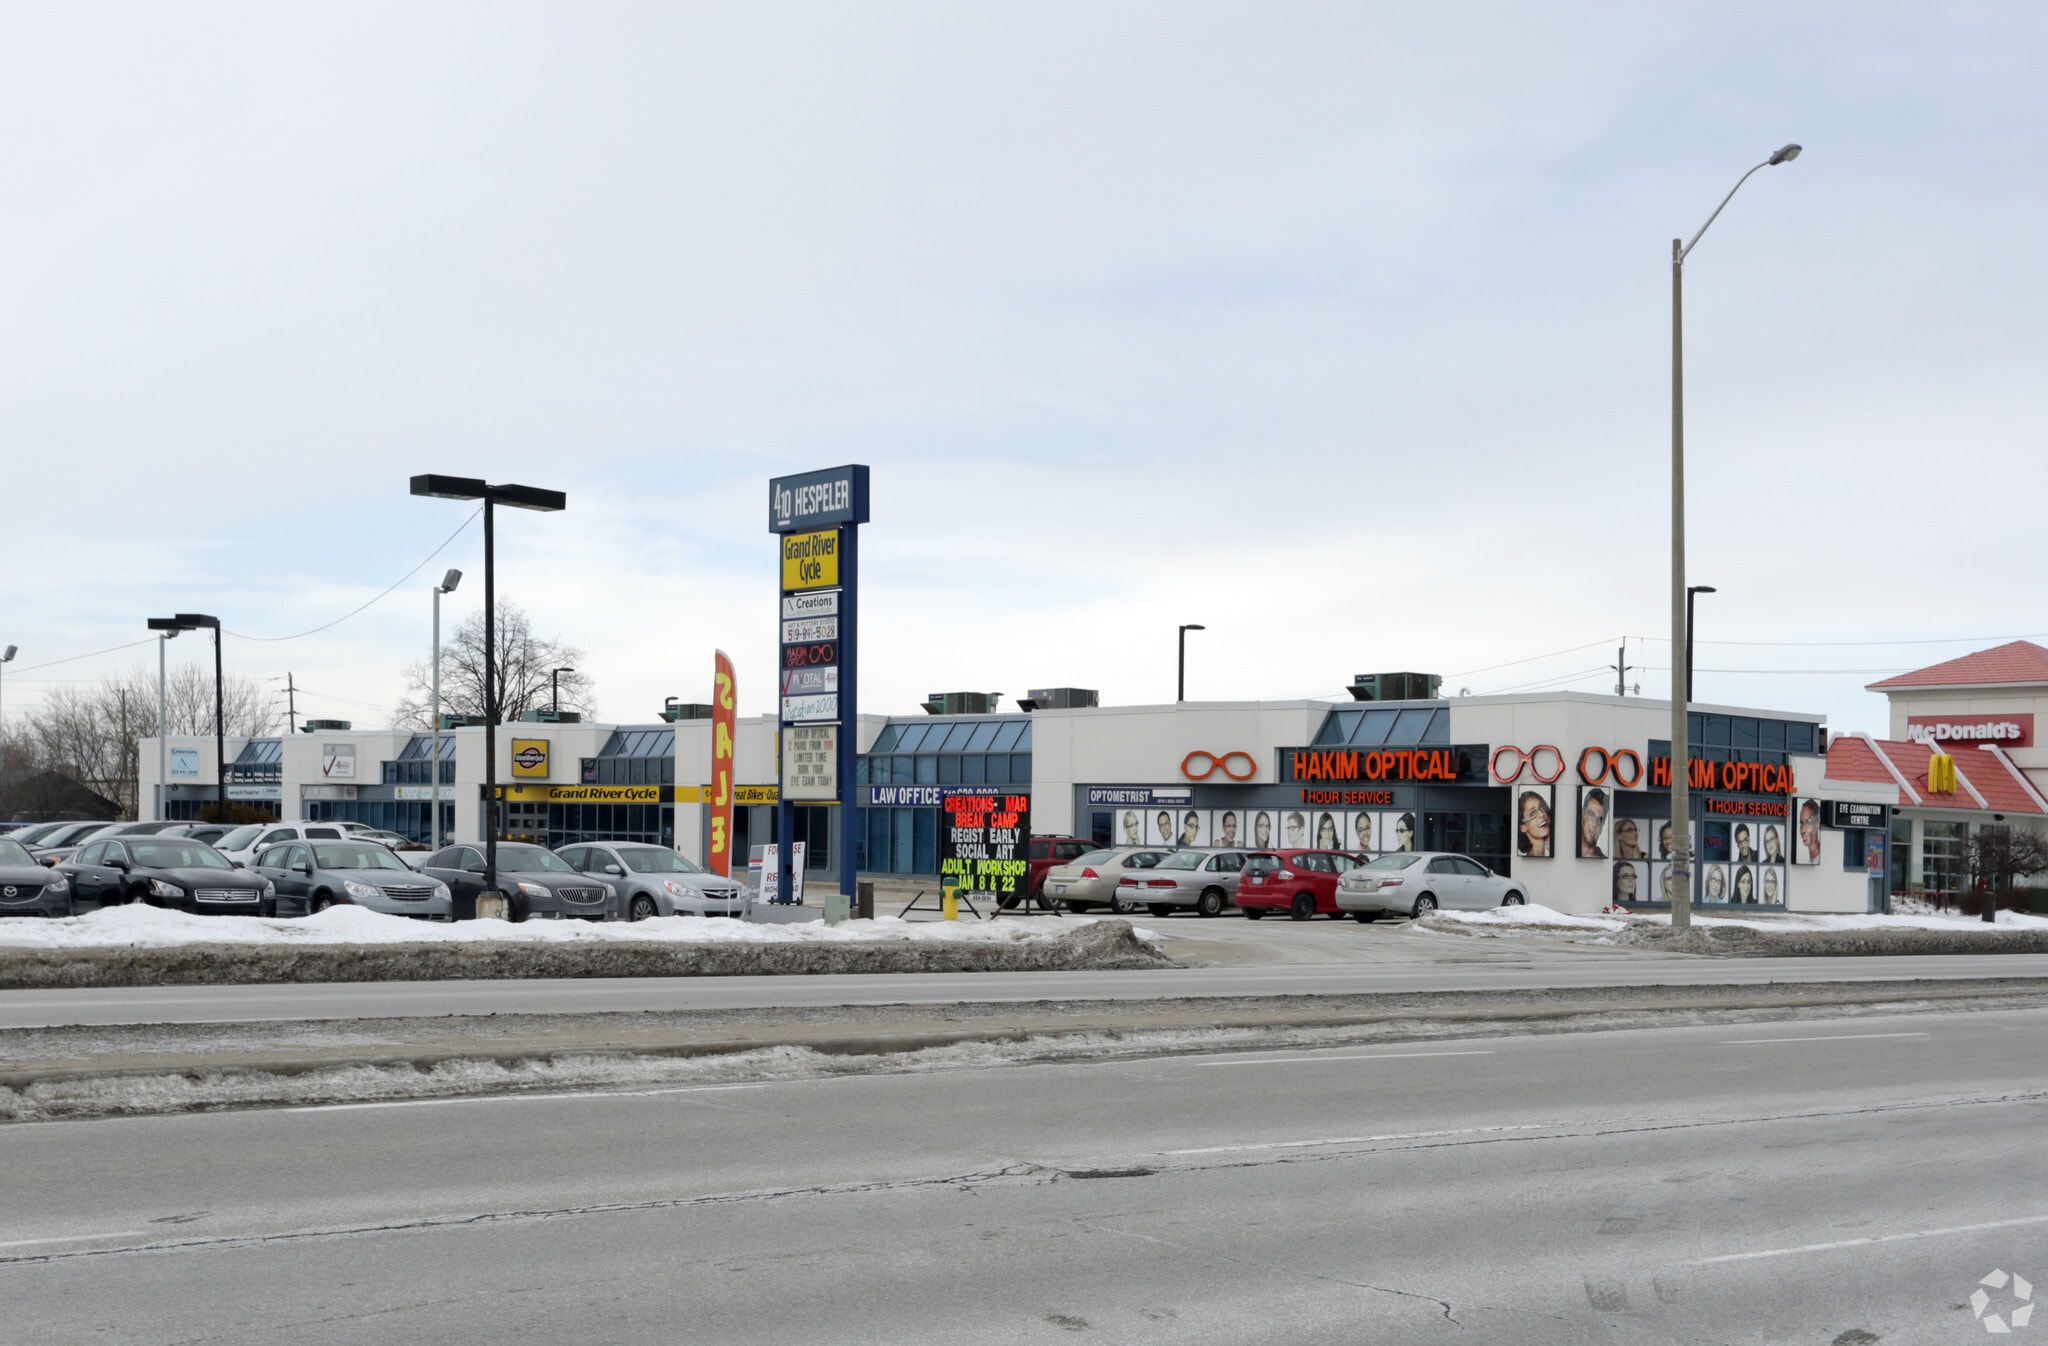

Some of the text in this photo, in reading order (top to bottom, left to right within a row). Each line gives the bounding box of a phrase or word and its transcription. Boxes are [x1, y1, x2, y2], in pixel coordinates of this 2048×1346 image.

[774, 480, 849, 520] 410 HESPELER
[785, 535, 836, 560] Grand River
[800, 559, 821, 584] Cycle
[797, 596, 832, 609] Creations
[787, 647, 807, 658] HAKIM
[788, 658, 807, 667] OPTICAL
[793, 673, 823, 686] PIVOTAL
[811, 728, 830, 739] OPTICAL
[1907, 722, 2021, 740] McDonald's
[788, 741, 793, 751] 2
[794, 752, 827, 763] LIMITED TIME
[1293, 750, 1457, 780] HAKIM OPTICAL
[802, 776, 815, 786] EXAM
[817, 776, 832, 786] TODAY
[1722, 761, 1798, 793] OPTICAL
[550, 788, 657, 801] Grand River Cycle
[734, 788, 747, 800] reat
[747, 788, 764, 800] Bikes
[872, 788, 896, 804] LAW
[899, 788, 940, 804] OFFICE
[1090, 790, 1150, 803] OPTOMETRIST
[1300, 789, 1391, 804] 1 HOUR SERVICE
[1006, 797, 1027, 812] MAR
[1708, 798, 1790, 816] 1 HOUR SERVICE
[1840, 804, 1881, 815] EYE EXAMINATION
[955, 813, 1019, 828] BREAK CAMP
[1851, 816, 1870, 825] CENTRE
[951, 828, 1021, 844] REGIST EARLY
[768, 845, 778, 856] FO
[956, 844, 1015, 860] SOCIAL ART
[941, 859, 1027, 876] ADULT WORKSHOP
[958, 875, 1016, 892] JAN 8 & 22
